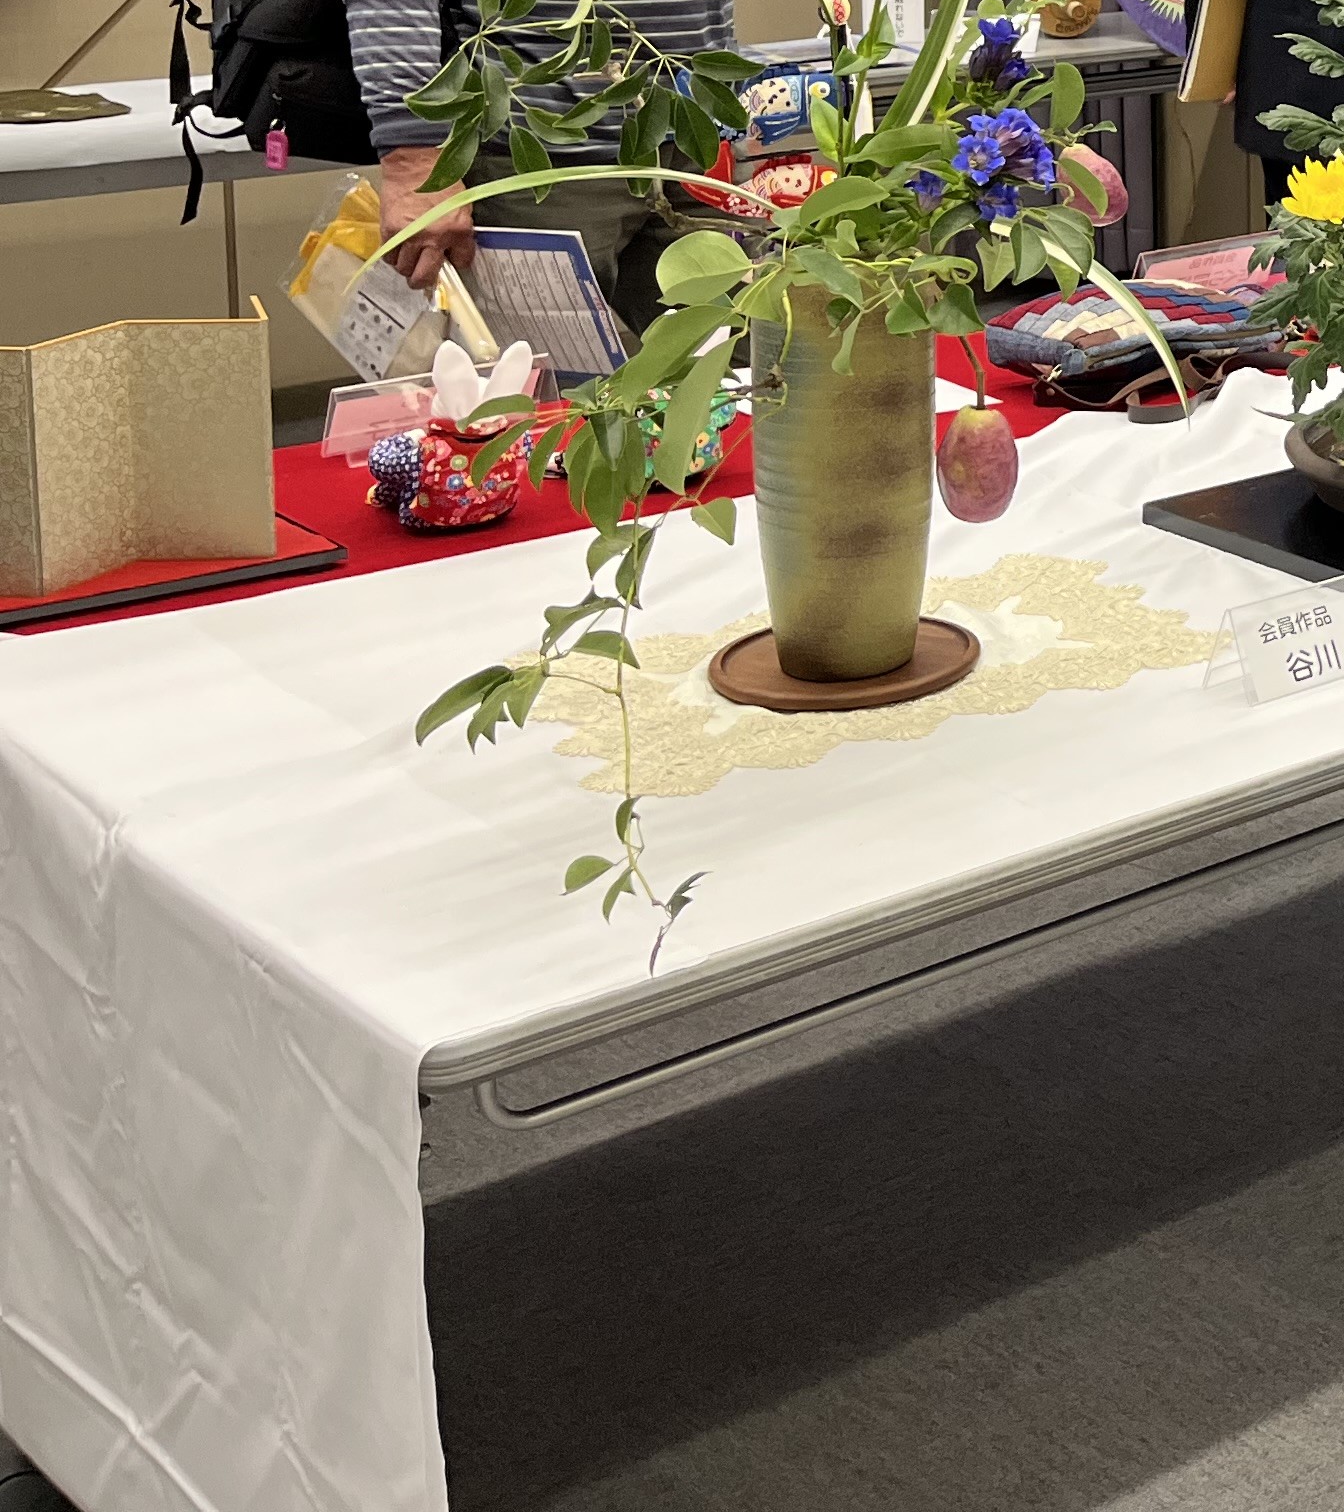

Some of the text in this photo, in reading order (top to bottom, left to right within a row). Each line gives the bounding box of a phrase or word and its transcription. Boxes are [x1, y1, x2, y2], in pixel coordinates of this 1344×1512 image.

[1257, 606, 1332, 644] 会員作品
[1286, 639, 1342, 682] 谷川
